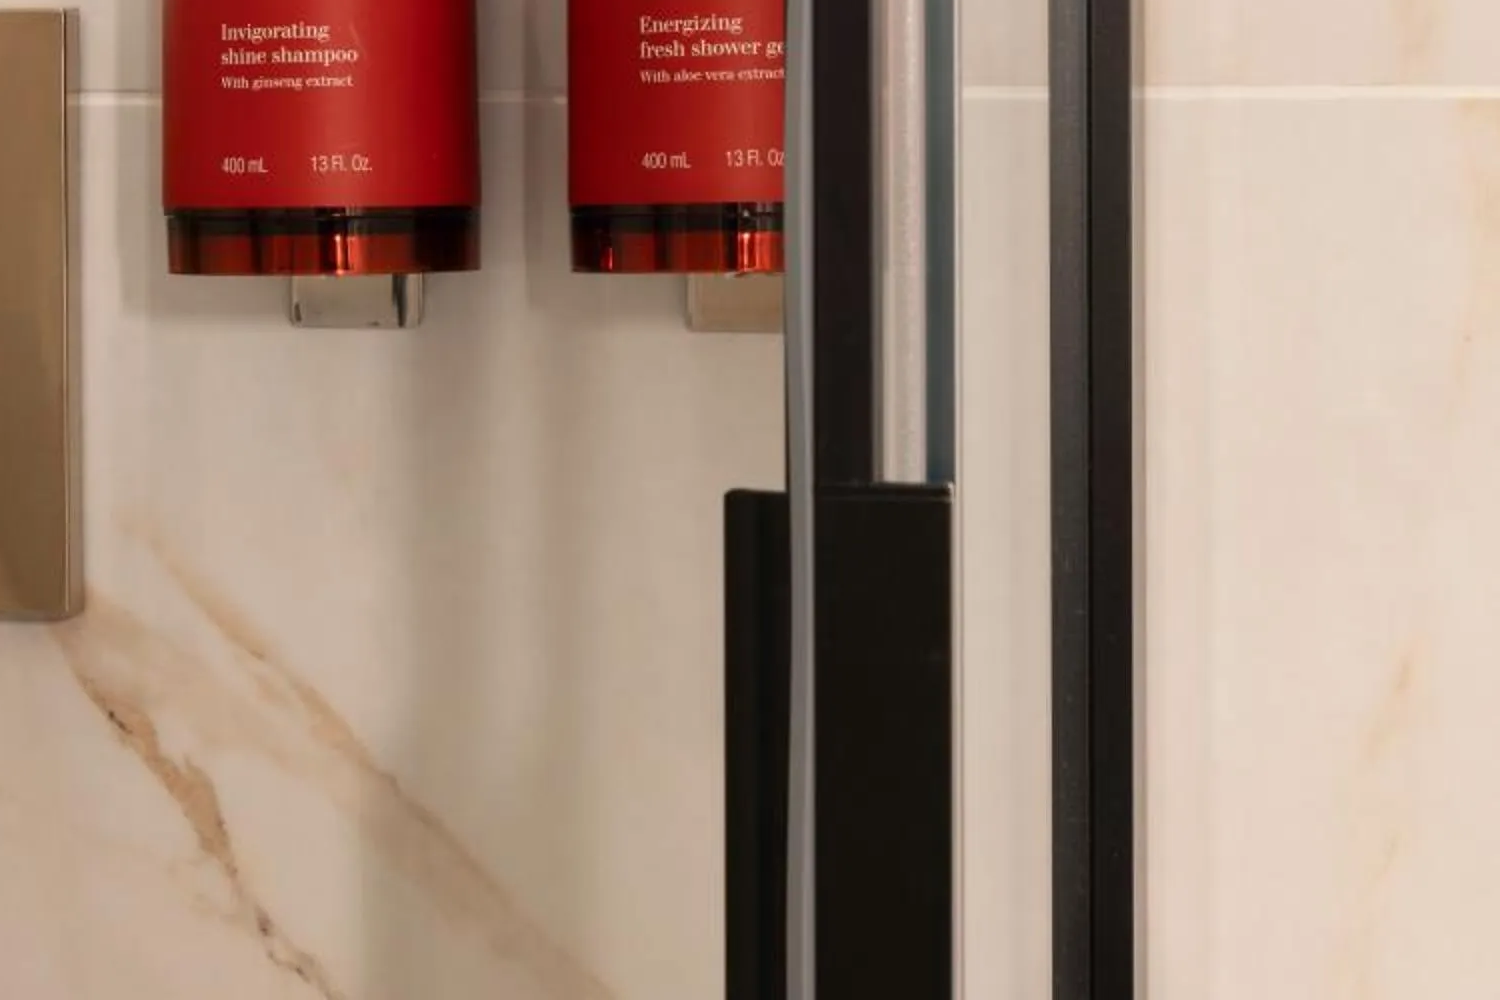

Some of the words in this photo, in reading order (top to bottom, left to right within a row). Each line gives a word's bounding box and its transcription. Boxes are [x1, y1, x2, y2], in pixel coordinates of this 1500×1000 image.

[221, 22, 331, 44] Invigorating
[640, 14, 744, 36] Energizing
[221, 48, 267, 64] shine
[272, 46, 359, 67] shampoo
[640, 41, 686, 59] fresh
[692, 39, 762, 56] shower
[766, 41, 784, 59] ge
[222, 76, 249, 88] With
[252, 76, 304, 91] ginseng
[306, 74, 353, 87] extract
[640, 70, 671, 83] With
[705, 70, 736, 82] vera
[222, 157, 245, 174] 400
[247, 157, 268, 173] mL
[311, 155, 330, 173] 13
[350, 153, 372, 172] Oz.
[642, 152, 667, 169] 400
[670, 152, 691, 168] mL
[725, 149, 744, 167] 13
